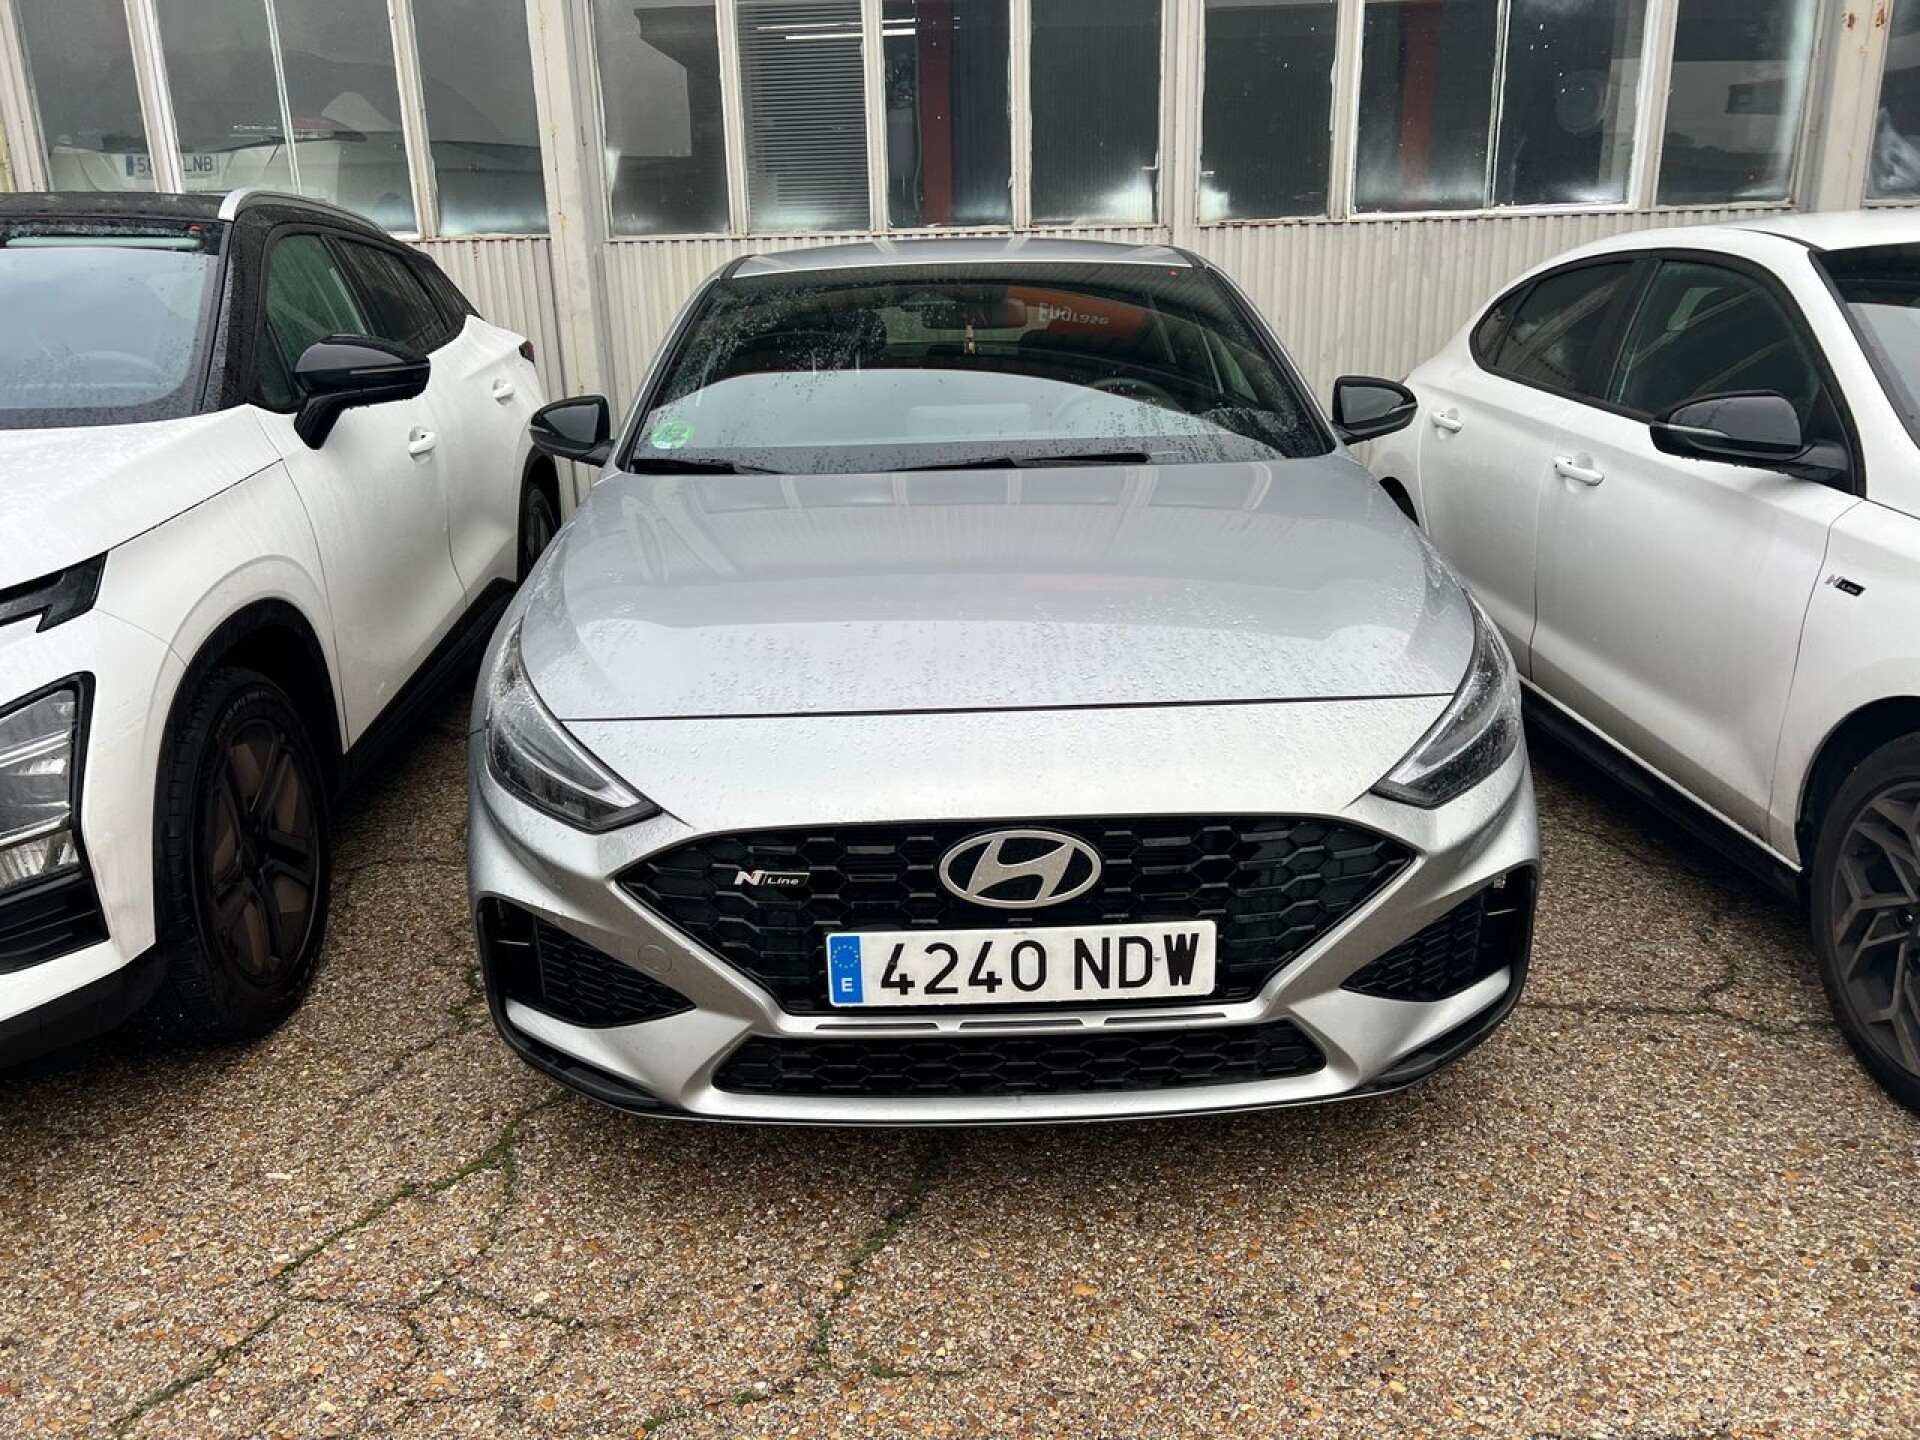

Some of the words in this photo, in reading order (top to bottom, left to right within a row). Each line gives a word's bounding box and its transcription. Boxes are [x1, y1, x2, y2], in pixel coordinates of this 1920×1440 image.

[733, 869, 765, 886] N
[767, 876, 800, 886] Line
[880, 939, 1047, 996] 4240
[1073, 932, 1200, 992] NDW
[840, 977, 853, 992] E
